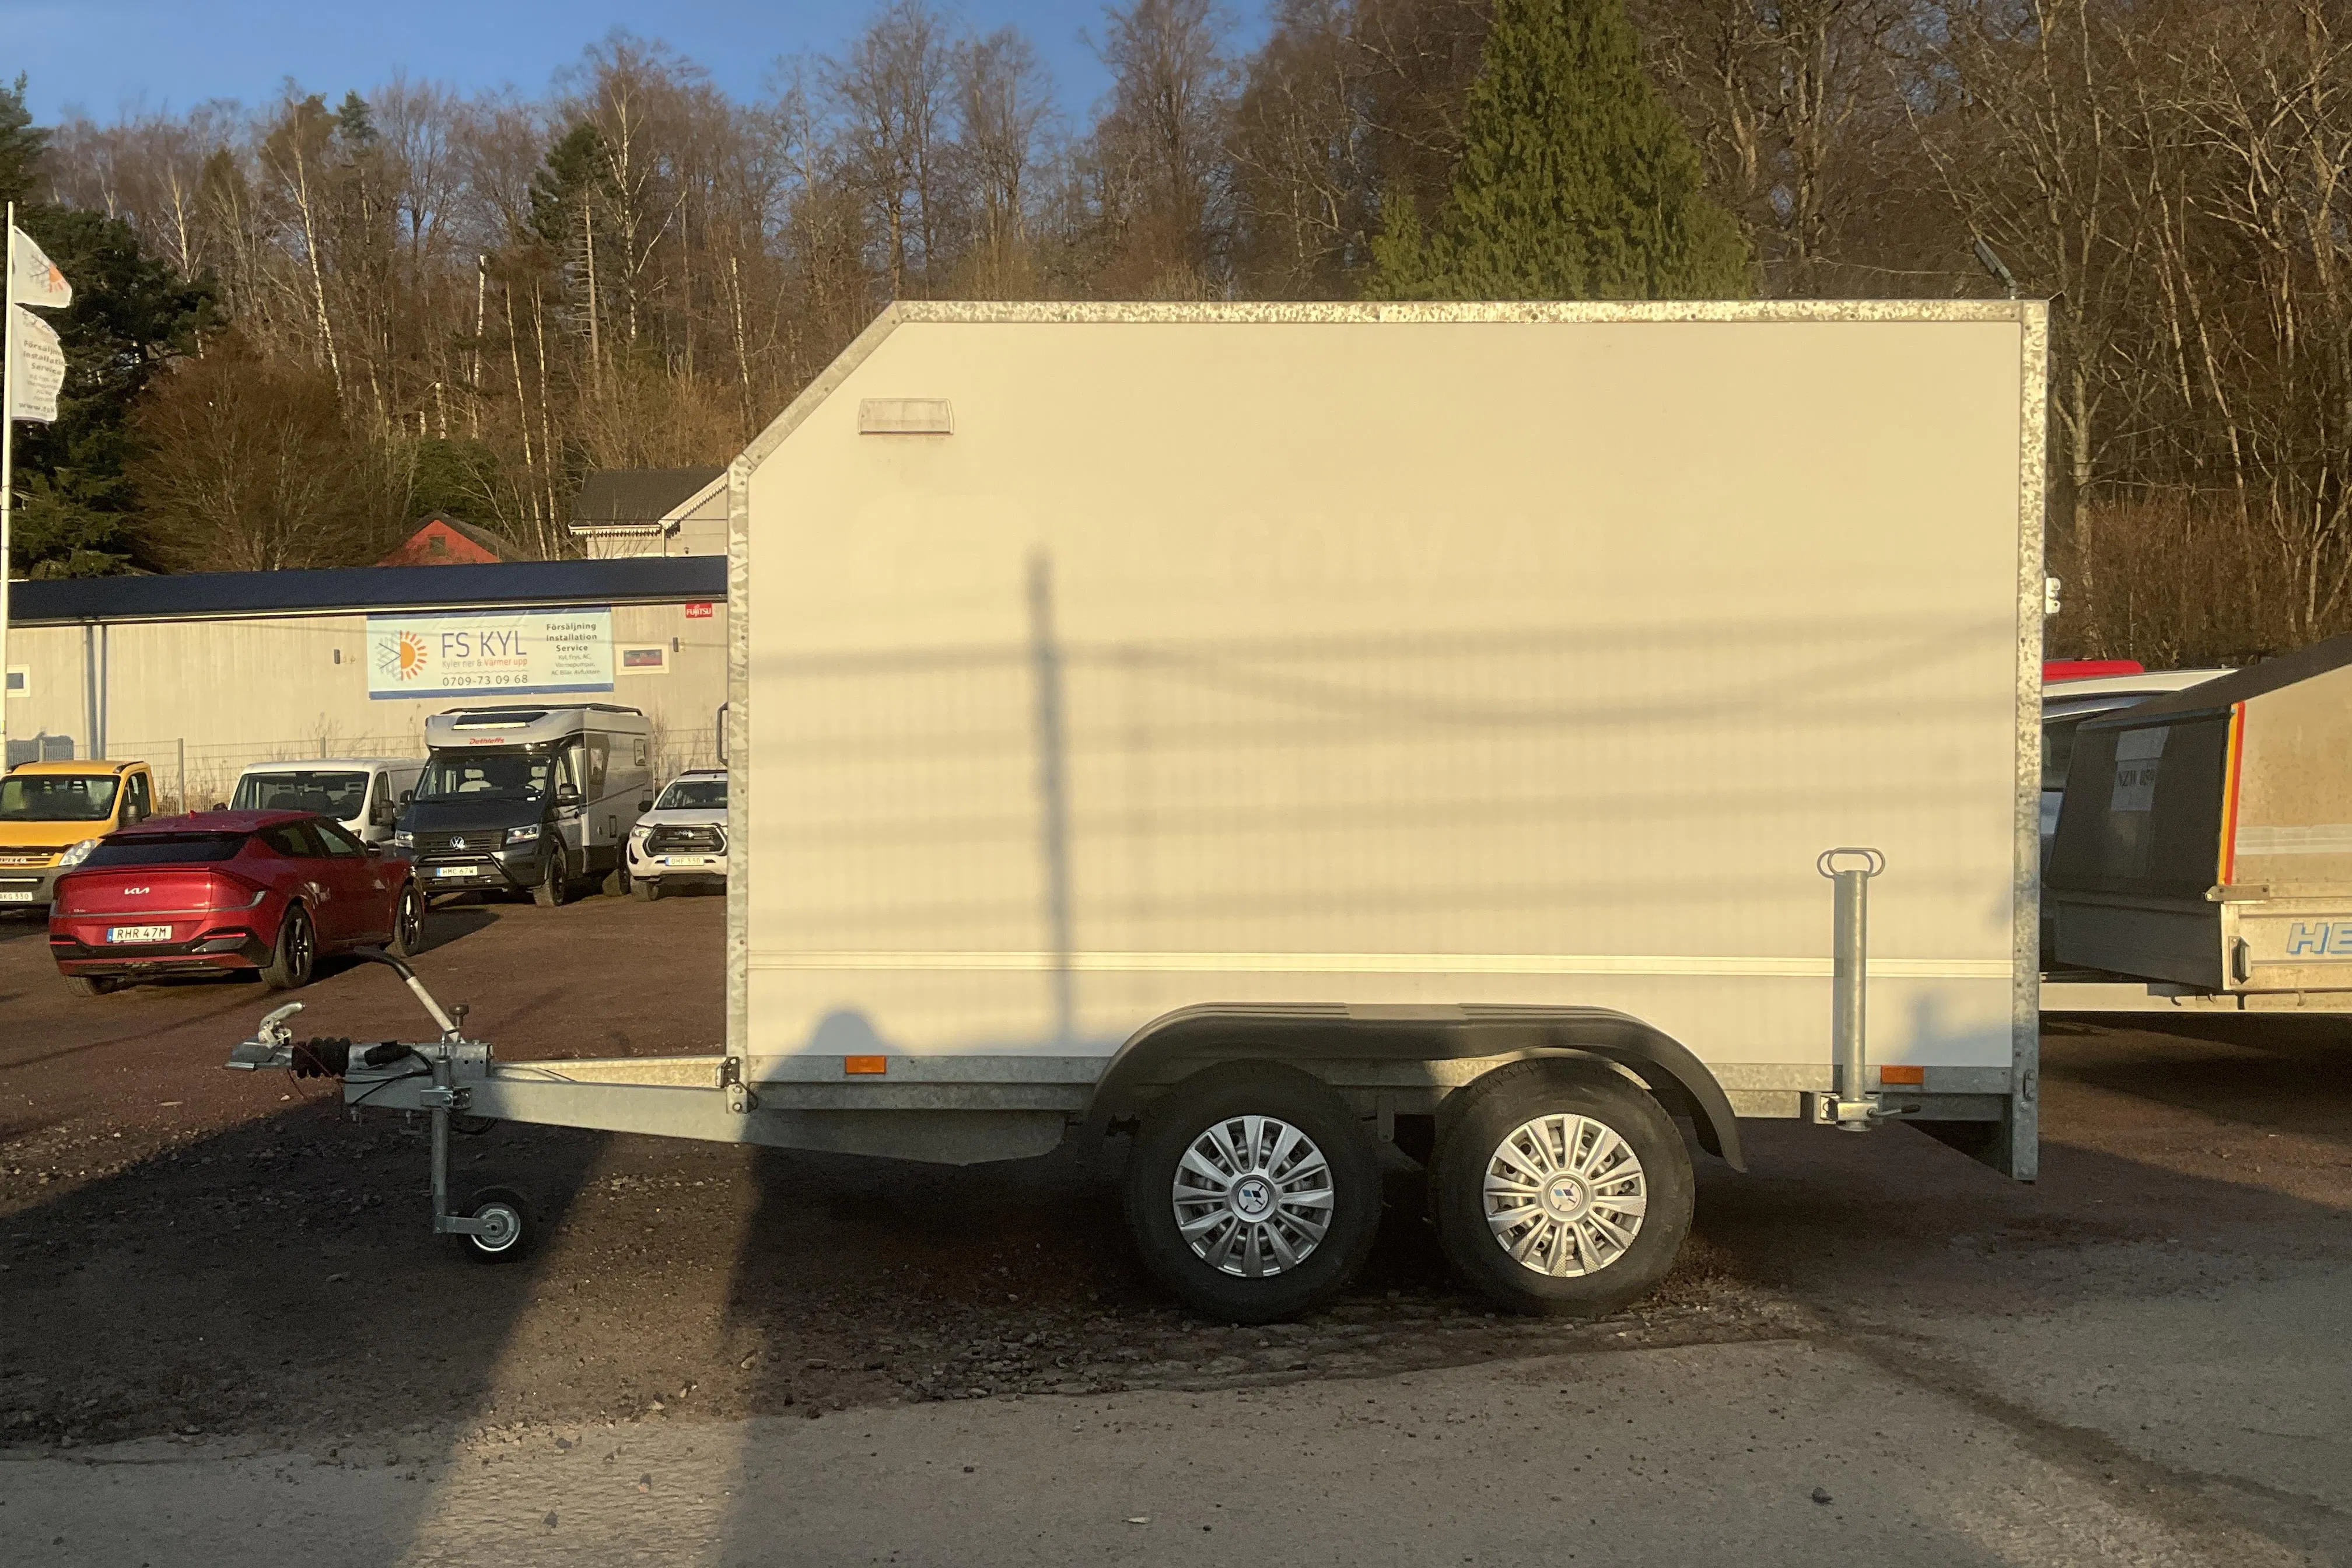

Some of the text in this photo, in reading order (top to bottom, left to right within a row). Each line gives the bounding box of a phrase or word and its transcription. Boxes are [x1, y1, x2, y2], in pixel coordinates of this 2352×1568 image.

[31, 362, 61, 376] Service
[687, 604, 711, 617] FUJITSU
[547, 622, 596, 631] Försäljning
[442, 631, 527, 658] FS KYL
[442, 660, 461, 668] Kyler
[484, 658, 511, 666] Värmer
[513, 658, 527, 666] upp
[443, 674, 528, 686] 0709-73 09 68
[124, 887, 150, 895] KIA
[117, 928, 166, 939] RHR 47M
